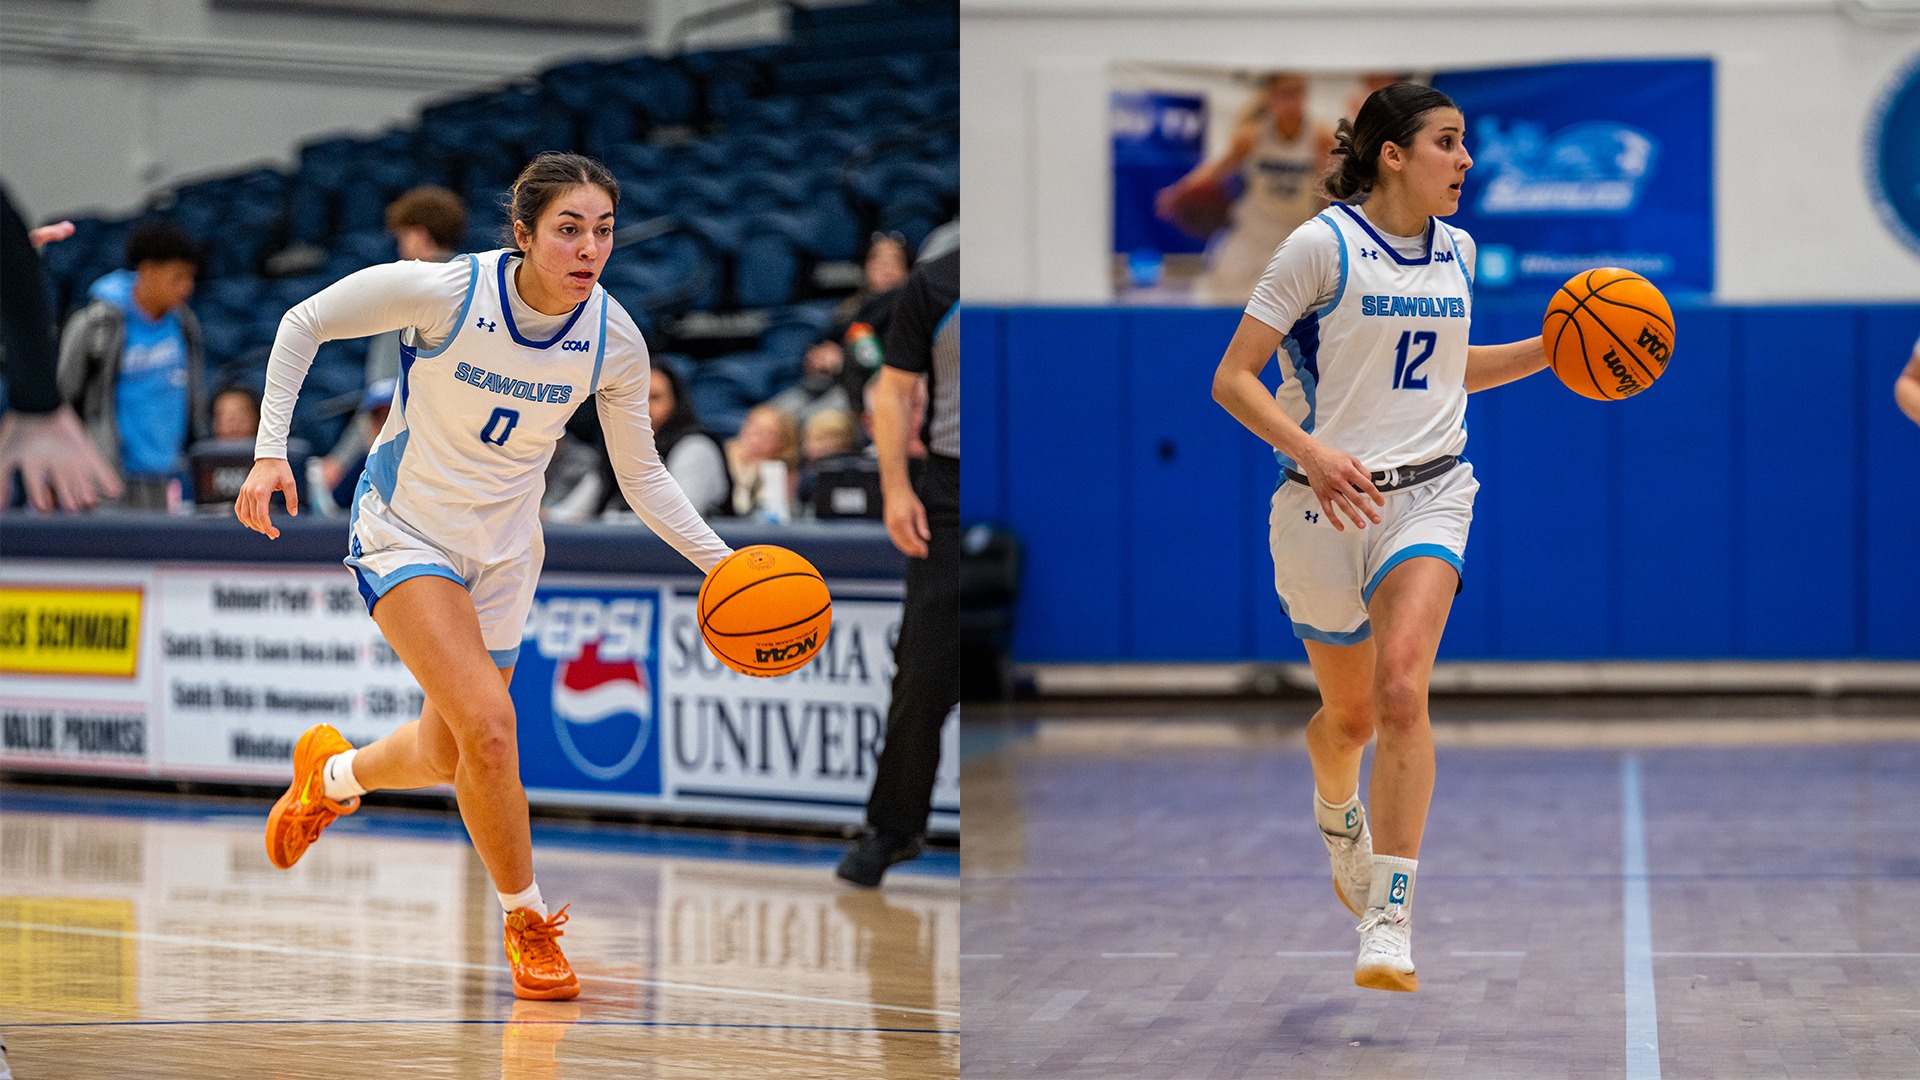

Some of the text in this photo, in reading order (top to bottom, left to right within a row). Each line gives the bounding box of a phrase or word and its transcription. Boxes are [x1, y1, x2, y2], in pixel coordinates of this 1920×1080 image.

[1361, 295, 1465, 318] SEAWOLVES
[561, 340, 590, 353] CCAA
[1391, 330, 1438, 390] 12
[454, 361, 573, 404] SEAWOLVES
[480, 406, 520, 447] 0
[755, 631, 818, 664] NCAA
